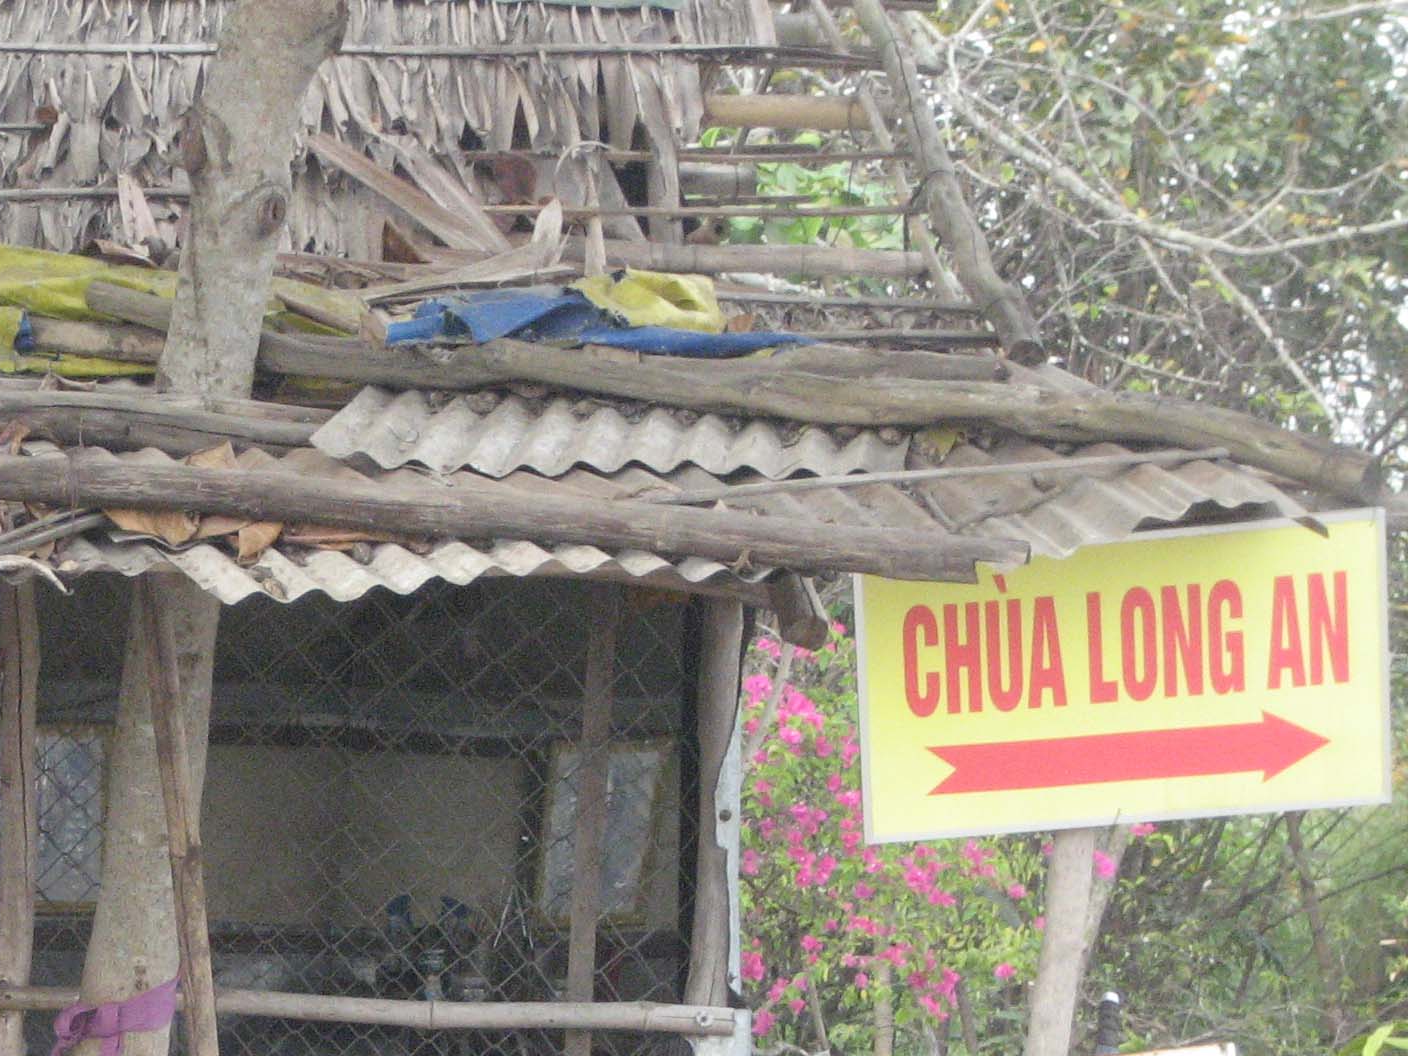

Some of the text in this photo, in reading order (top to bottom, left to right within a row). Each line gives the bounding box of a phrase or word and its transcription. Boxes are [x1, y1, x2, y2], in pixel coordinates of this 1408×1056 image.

[902, 570, 1350, 718] CHÙA LONG AN
